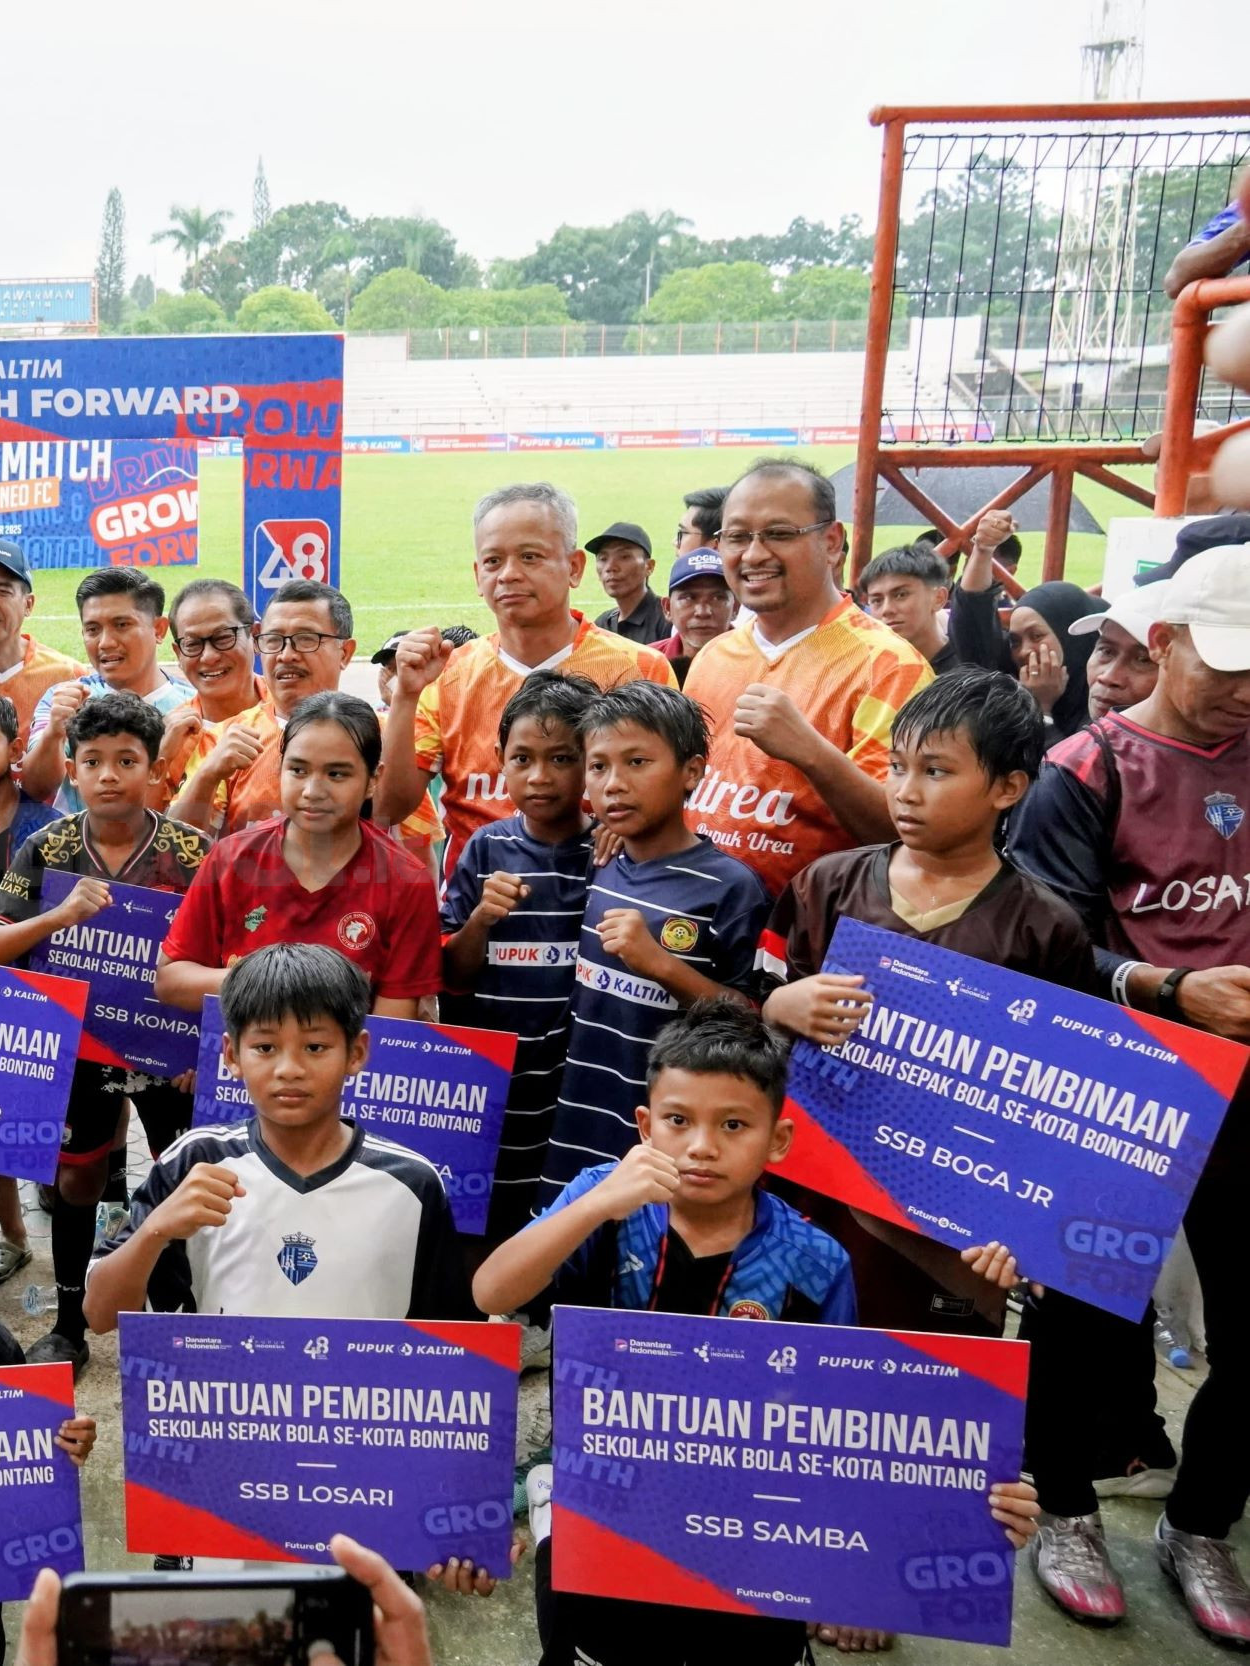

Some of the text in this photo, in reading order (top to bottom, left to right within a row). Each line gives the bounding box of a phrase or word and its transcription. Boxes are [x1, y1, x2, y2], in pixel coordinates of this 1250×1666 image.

[31, 386, 240, 417] FORWARD
[1, 439, 112, 482] MATCH
[33, 481, 52, 504] FC
[4, 523, 22, 535] 2025
[747, 832, 794, 855] Urea
[50, 923, 153, 964] BANTUAN
[613, 977, 671, 1005] KALTIM
[94, 1004, 129, 1022] SSB
[1003, 992, 1038, 1026] 48
[1051, 1013, 1178, 1064] PUPUK KALTIM
[979, 1044, 1190, 1150] PEMBINAAN
[895, 1059, 954, 1097] SEPAK
[952, 1080, 1002, 1115] BOLA
[1000, 1098, 1081, 1144] SE-KOTA
[1080, 1127, 1172, 1178] BONTANG
[875, 1125, 1054, 1208] SSB BOCA JR
[303, 1335, 328, 1359] 48
[347, 1343, 464, 1356] PUPUK KALTIM
[766, 1344, 797, 1374] 48
[818, 1355, 959, 1377] PUPUK KALTIM
[147, 1378, 491, 1425] BANTUAN PEMBINAAN
[149, 1418, 489, 1450] SEKOLAH SEPAK BOLA SE-KOTA BONTANG
[583, 1386, 990, 1461] BANTUAN PEMBINAAN
[583, 1432, 986, 1491] SEKOLAH SEPAK BOLA SE-KOTA BONTANG
[239, 1483, 394, 1506] SSB LOSARI
[685, 1513, 869, 1552] SSB SAMBA
